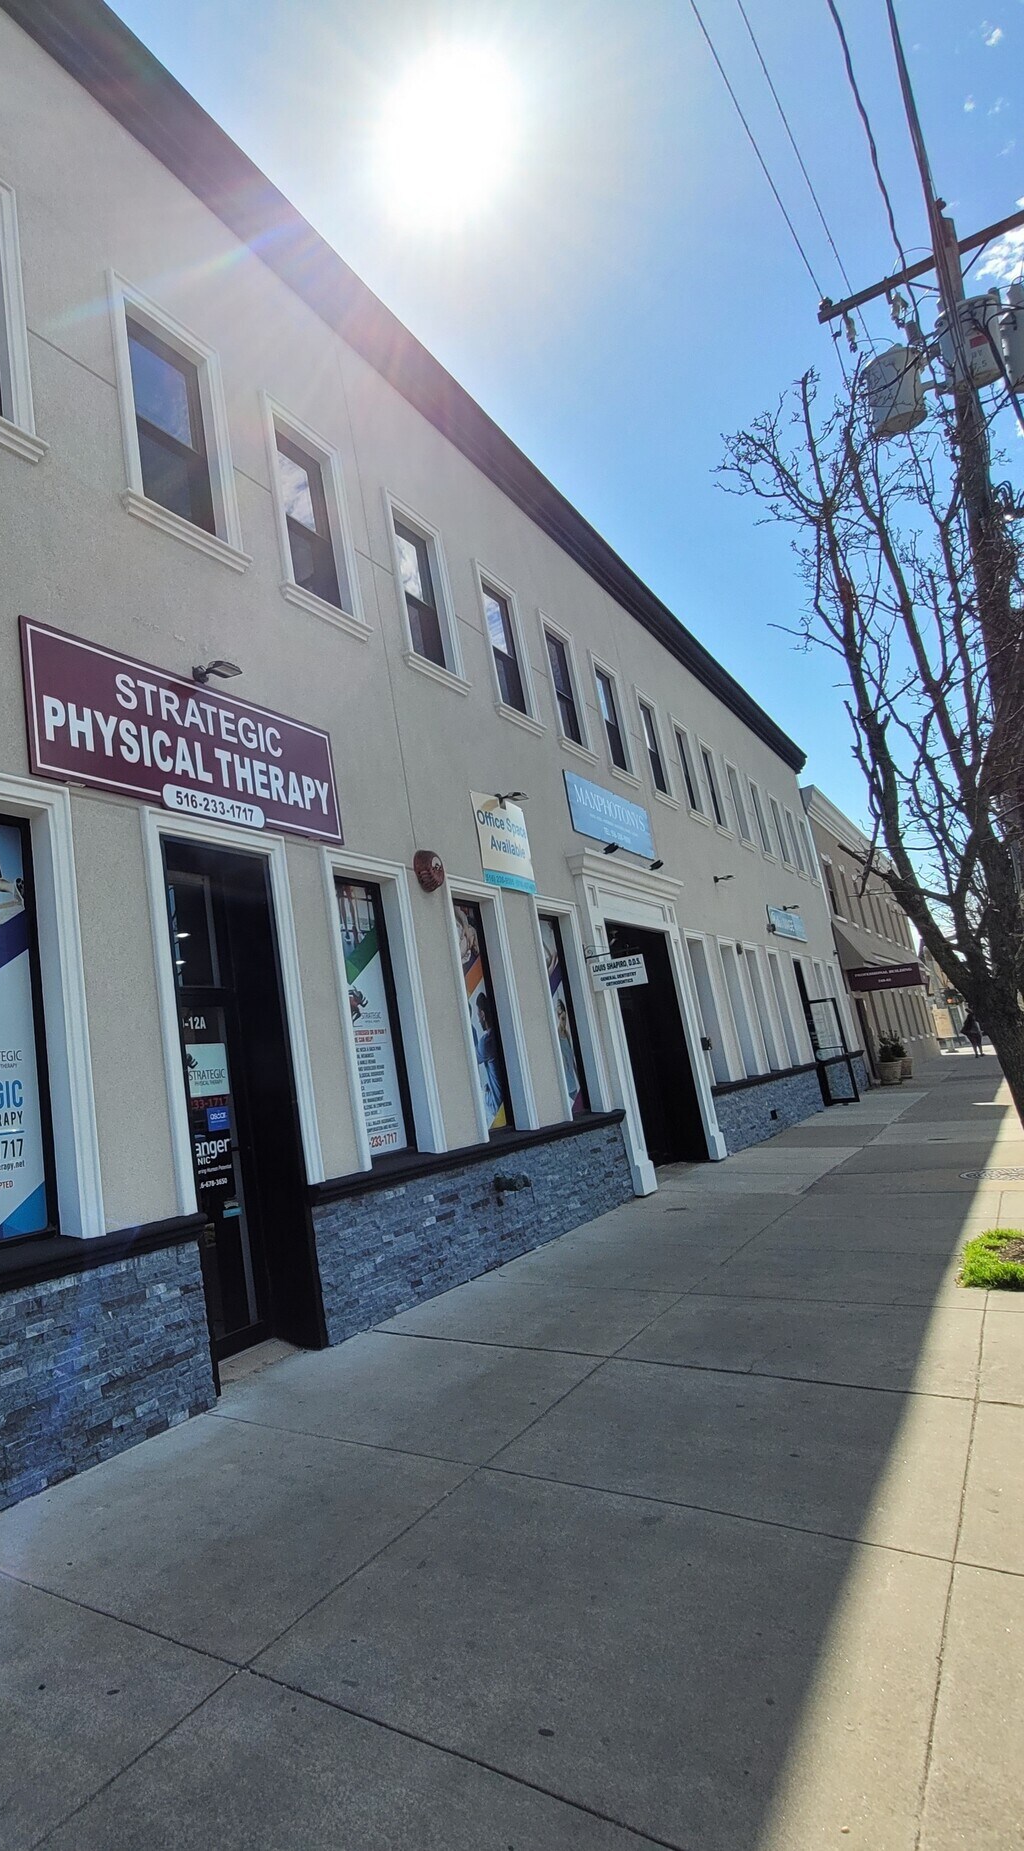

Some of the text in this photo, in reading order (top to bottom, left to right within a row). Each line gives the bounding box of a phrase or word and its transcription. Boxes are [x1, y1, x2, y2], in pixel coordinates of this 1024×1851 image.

[115, 673, 283, 758] STRATEGIC
[42, 694, 329, 815] PHYSICAL THERAPY
[175, 790, 255, 823] 516-233-1717
[476, 809, 505, 830] Office
[490, 834, 526, 859] Available
[592, 963, 607, 973] LOUIS
[606, 960, 628, 970] SHAPIRO,
[616, 971, 637, 979] DENTISTRY
[182, 1016, 207, 1030] -12A
[188, 1068, 226, 1081] STRATEGIC
